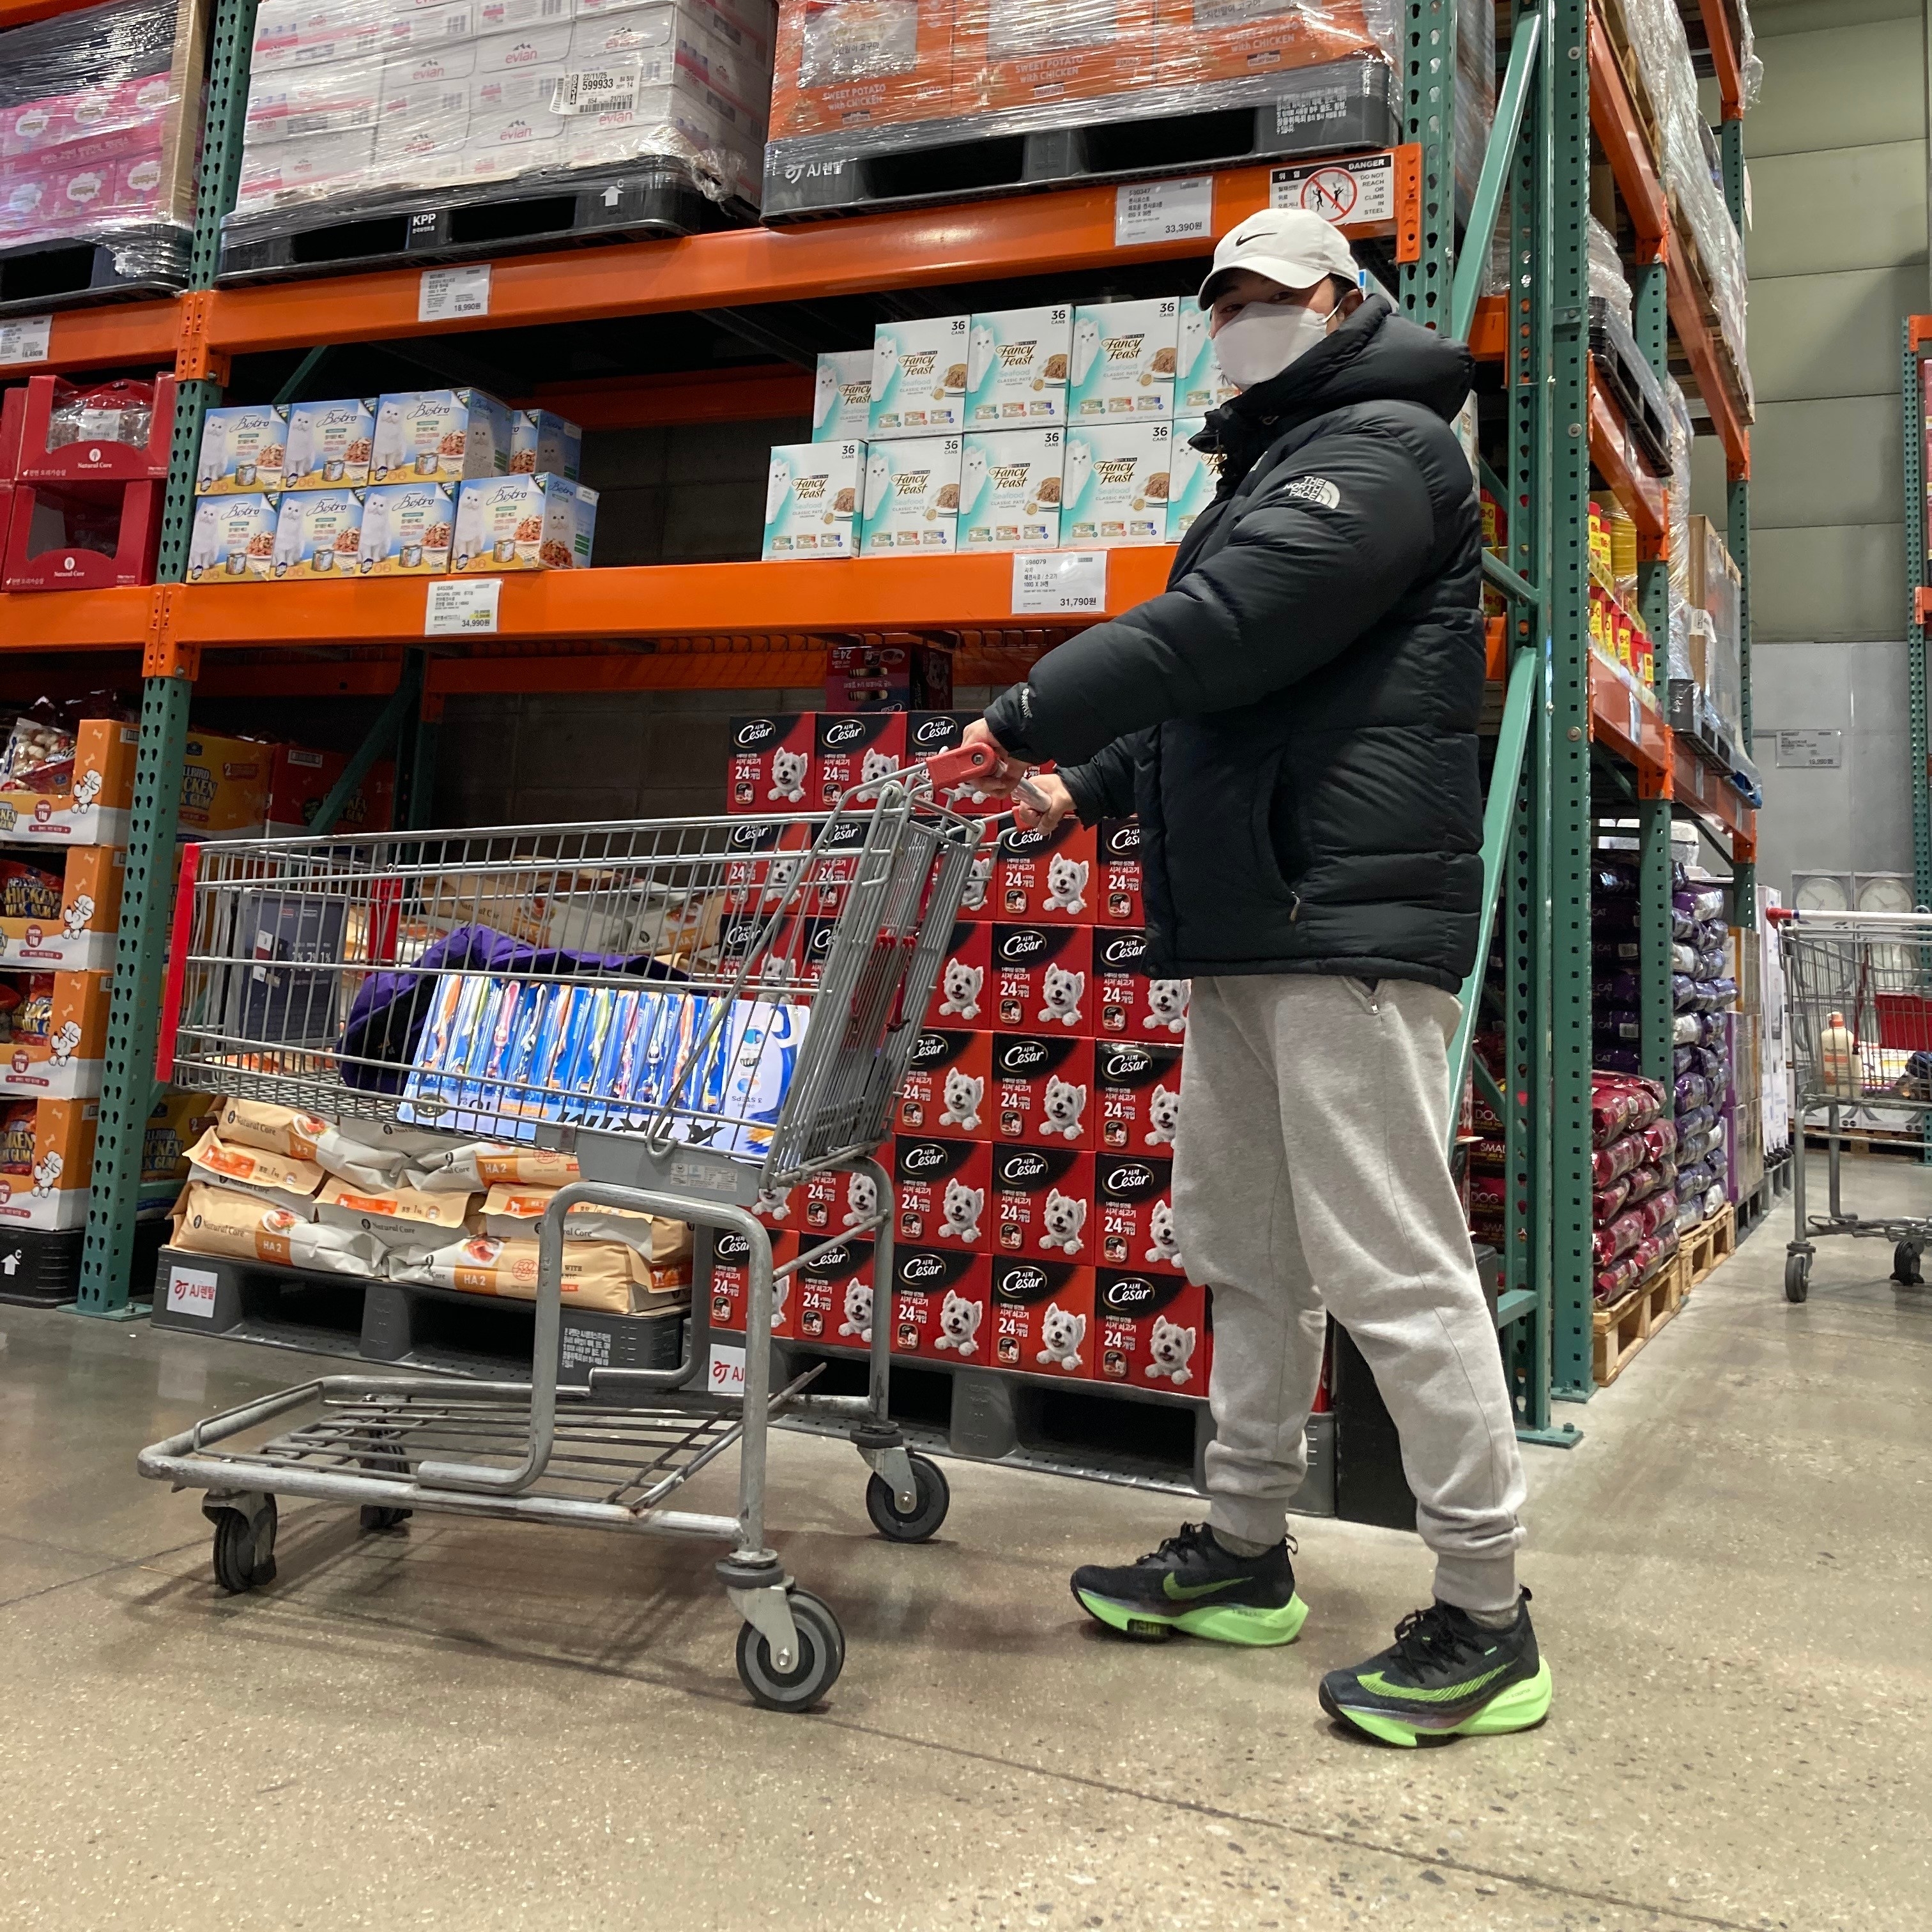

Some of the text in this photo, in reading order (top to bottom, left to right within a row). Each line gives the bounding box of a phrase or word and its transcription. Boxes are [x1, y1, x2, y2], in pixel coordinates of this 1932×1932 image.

[1230, 33, 1296, 53] with CHICKEN
[505, 49, 537, 64] evian
[1015, 57, 1084, 74] SWEET POTATO
[413, 66, 444, 80] evian
[1020, 67, 1080, 84] with CHICKEN
[582, 79, 613, 90] 599933
[823, 84, 887, 100] SWEET POTATO
[828, 95, 883, 110] with CHICKEN
[599, 111, 632, 125] evian
[500, 127, 532, 141] evian
[1348, 158, 1385, 171] DANGER
[1362, 179, 1385, 187] REACH
[413, 213, 436, 226] KPP
[1165, 221, 1202, 234] 33,390원
[1160, 302, 1174, 313] 36
[1051, 310, 1066, 320] 36
[951, 321, 965, 330] 36
[995, 345, 1036, 358] Fancy
[1101, 338, 1144, 351] Fancy
[898, 354, 937, 368] Fancy
[1000, 354, 1035, 369] Feast
[1106, 348, 1142, 363] Feast
[900, 364, 936, 378] Feast
[838, 383, 872, 397] Fancy
[843, 393, 871, 406] Feast
[407, 401, 450, 420] Bistro
[229, 415, 270, 433] Bistro
[316, 409, 358, 428] Bistro
[1045, 433, 1059, 442] 36
[1153, 427, 1168, 437] 36
[841, 445, 855, 455] 36
[944, 440, 958, 450] 36
[988, 466, 1030, 479] Fancy
[1094, 461, 1136, 474] Fancy
[792, 478, 828, 489] Fancy
[891, 473, 930, 485] Fancy
[993, 477, 1029, 490] Feast
[1098, 472, 1135, 485] Feast
[1304, 476, 1326, 487] THE
[486, 486, 527, 506] Bistro
[794, 487, 826, 501] Feast
[894, 483, 928, 497] Feast
[992, 491, 1023, 500] Seafood
[1283, 482, 1322, 496] NORTH
[1289, 488, 1317, 501] FACE
[306, 498, 347, 517] Bistro
[392, 493, 434, 512] Bistro
[220, 502, 260, 521] Bistro
[1060, 597, 1096, 608] 31,790원
[461, 619, 490, 627] 34,990원
[1591, 908, 1607, 917] CAT
[1106, 941, 1147, 961] Cesar
[1597, 983, 1613, 992] CAT
[1004, 1046, 1044, 1066] Cesar
[1595, 1054, 1612, 1063] CAT
[1107, 1055, 1148, 1075] Cesar
[237, 1115, 276, 1137] Natural Core
[905, 1149, 944, 1169] Cesar
[454, 1165, 470, 1174] Core
[484, 1163, 508, 1173] HA 2
[1004, 1158, 1044, 1178] Cesar
[1108, 1169, 1149, 1190] Cesar
[808, 1184, 824, 1199] 24
[1471, 1192, 1499, 1204] DOG
[901, 1194, 918, 1210] 24
[1000, 1204, 1018, 1221] 24
[203, 1220, 245, 1237] Natural Core
[372, 1221, 415, 1234] Natural Core
[1104, 1216, 1123, 1233] 24
[574, 1228, 592, 1238] Core
[263, 1240, 282, 1252] HA 2
[15, 1249, 22, 1259] C
[903, 1259, 942, 1278] Cesar
[463, 1275, 486, 1286] HA 2
[713, 1278, 728, 1294] 24
[1002, 1271, 1043, 1291] Cesar
[189, 1282, 216, 1301] AJ렌탈
[1108, 1282, 1150, 1303] Cesar
[802, 1292, 820, 1308] 24
[898, 1305, 915, 1321] 24
[998, 1317, 1016, 1335] 24
[1104, 1330, 1122, 1347] 24
